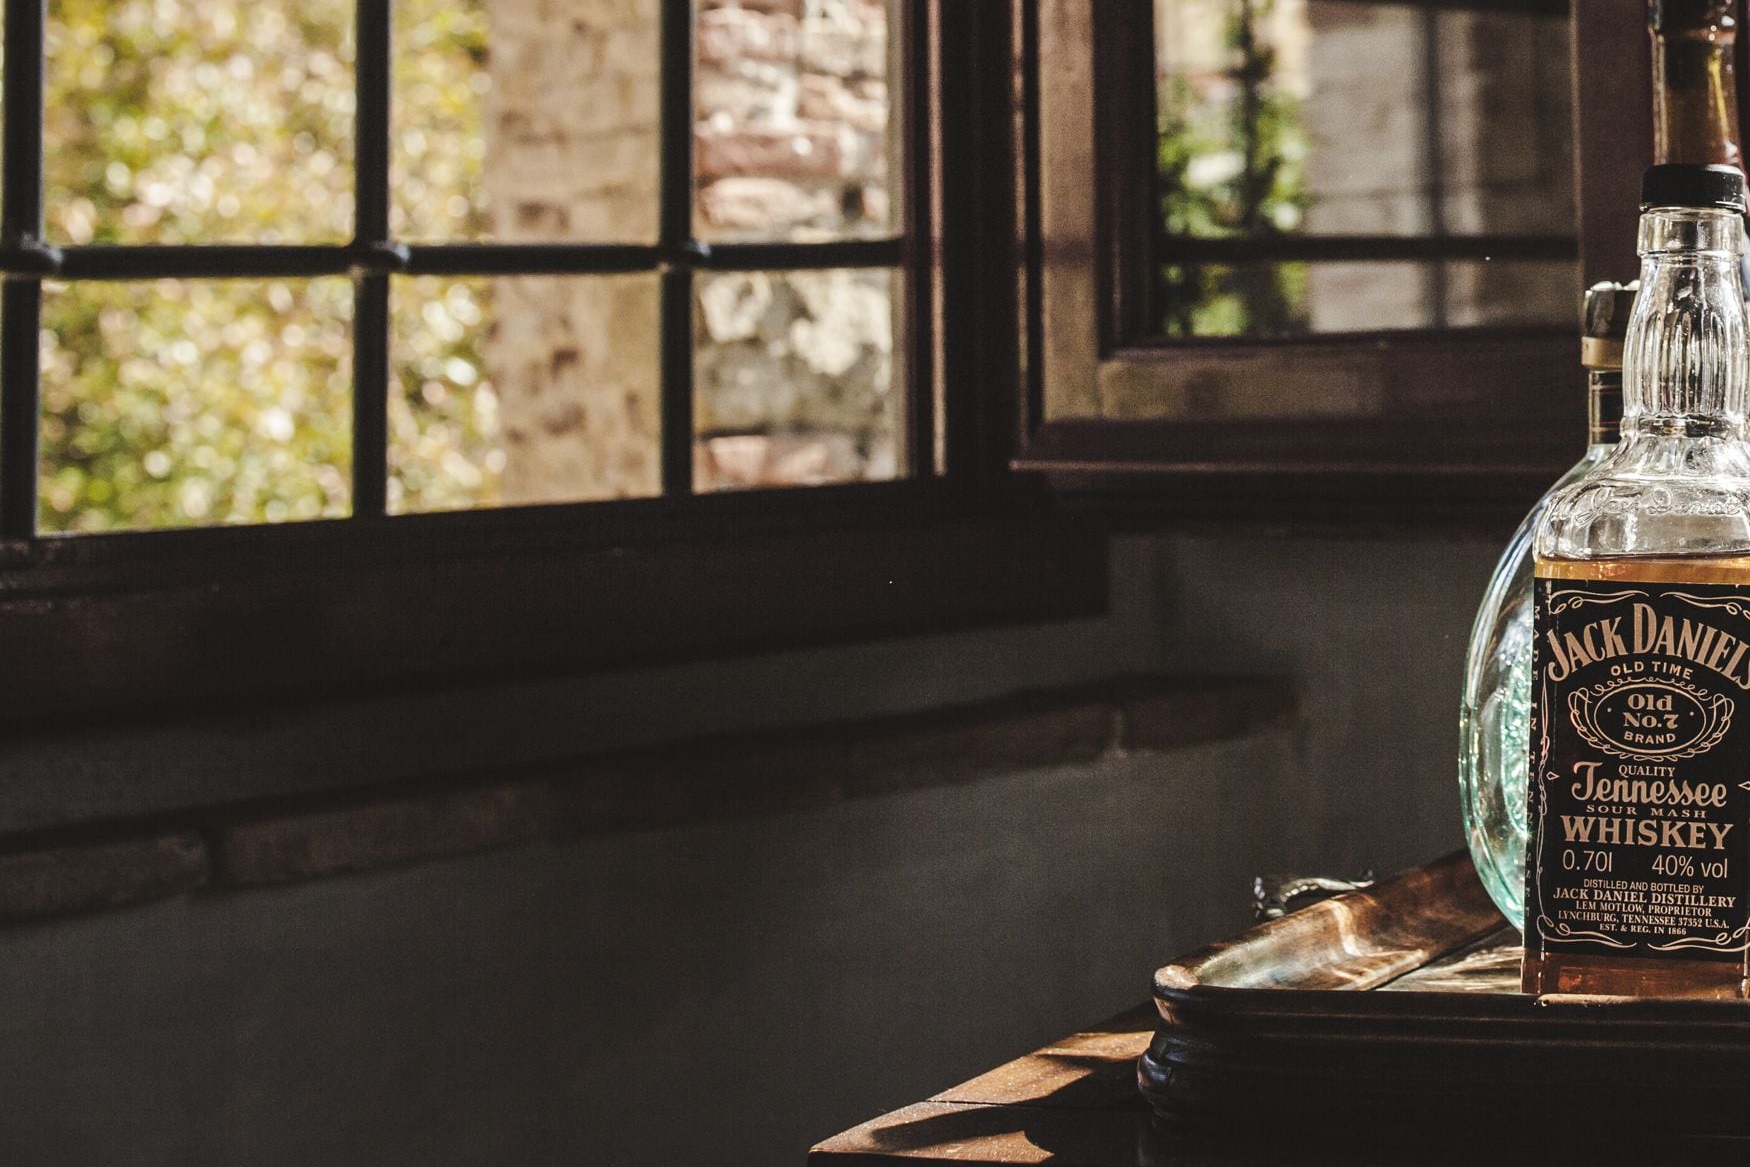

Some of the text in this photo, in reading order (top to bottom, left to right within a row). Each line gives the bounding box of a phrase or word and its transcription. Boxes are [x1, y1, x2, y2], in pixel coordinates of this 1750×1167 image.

[1546, 616, 1628, 682] JACK
[1610, 661, 1694, 680] OLD TIME
[1627, 694, 1673, 711] Old
[1623, 731, 1676, 744] BRAND
[1525, 605, 1540, 917] MADE IN TENNSSEE
[1618, 764, 1676, 778] QUALITY
[1571, 761, 1728, 808] Tennessee
[1586, 804, 1707, 819] SOUR MASH
[1560, 815, 1735, 850] WHISKEY
[1651, 854, 1695, 877] 40%
[1701, 858, 1728, 879] vol
[1583, 879, 1705, 894] DISTILLED AND BOTTLED BY
[1553, 887, 1737, 908] JACK DANIEL DISTILLERY
[1576, 901, 1712, 917] LEM MOTLOW, PROPRIETOR
[1558, 910, 1620, 923] LYNCHBURG,
[1621, 913, 1676, 926] TENNESSEE
[1705, 918, 1730, 929] U.S.A.
[1600, 923, 1618, 931] EST.
[1630, 926, 1651, 934] REG.
[1668, 927, 1687, 935] 1866
